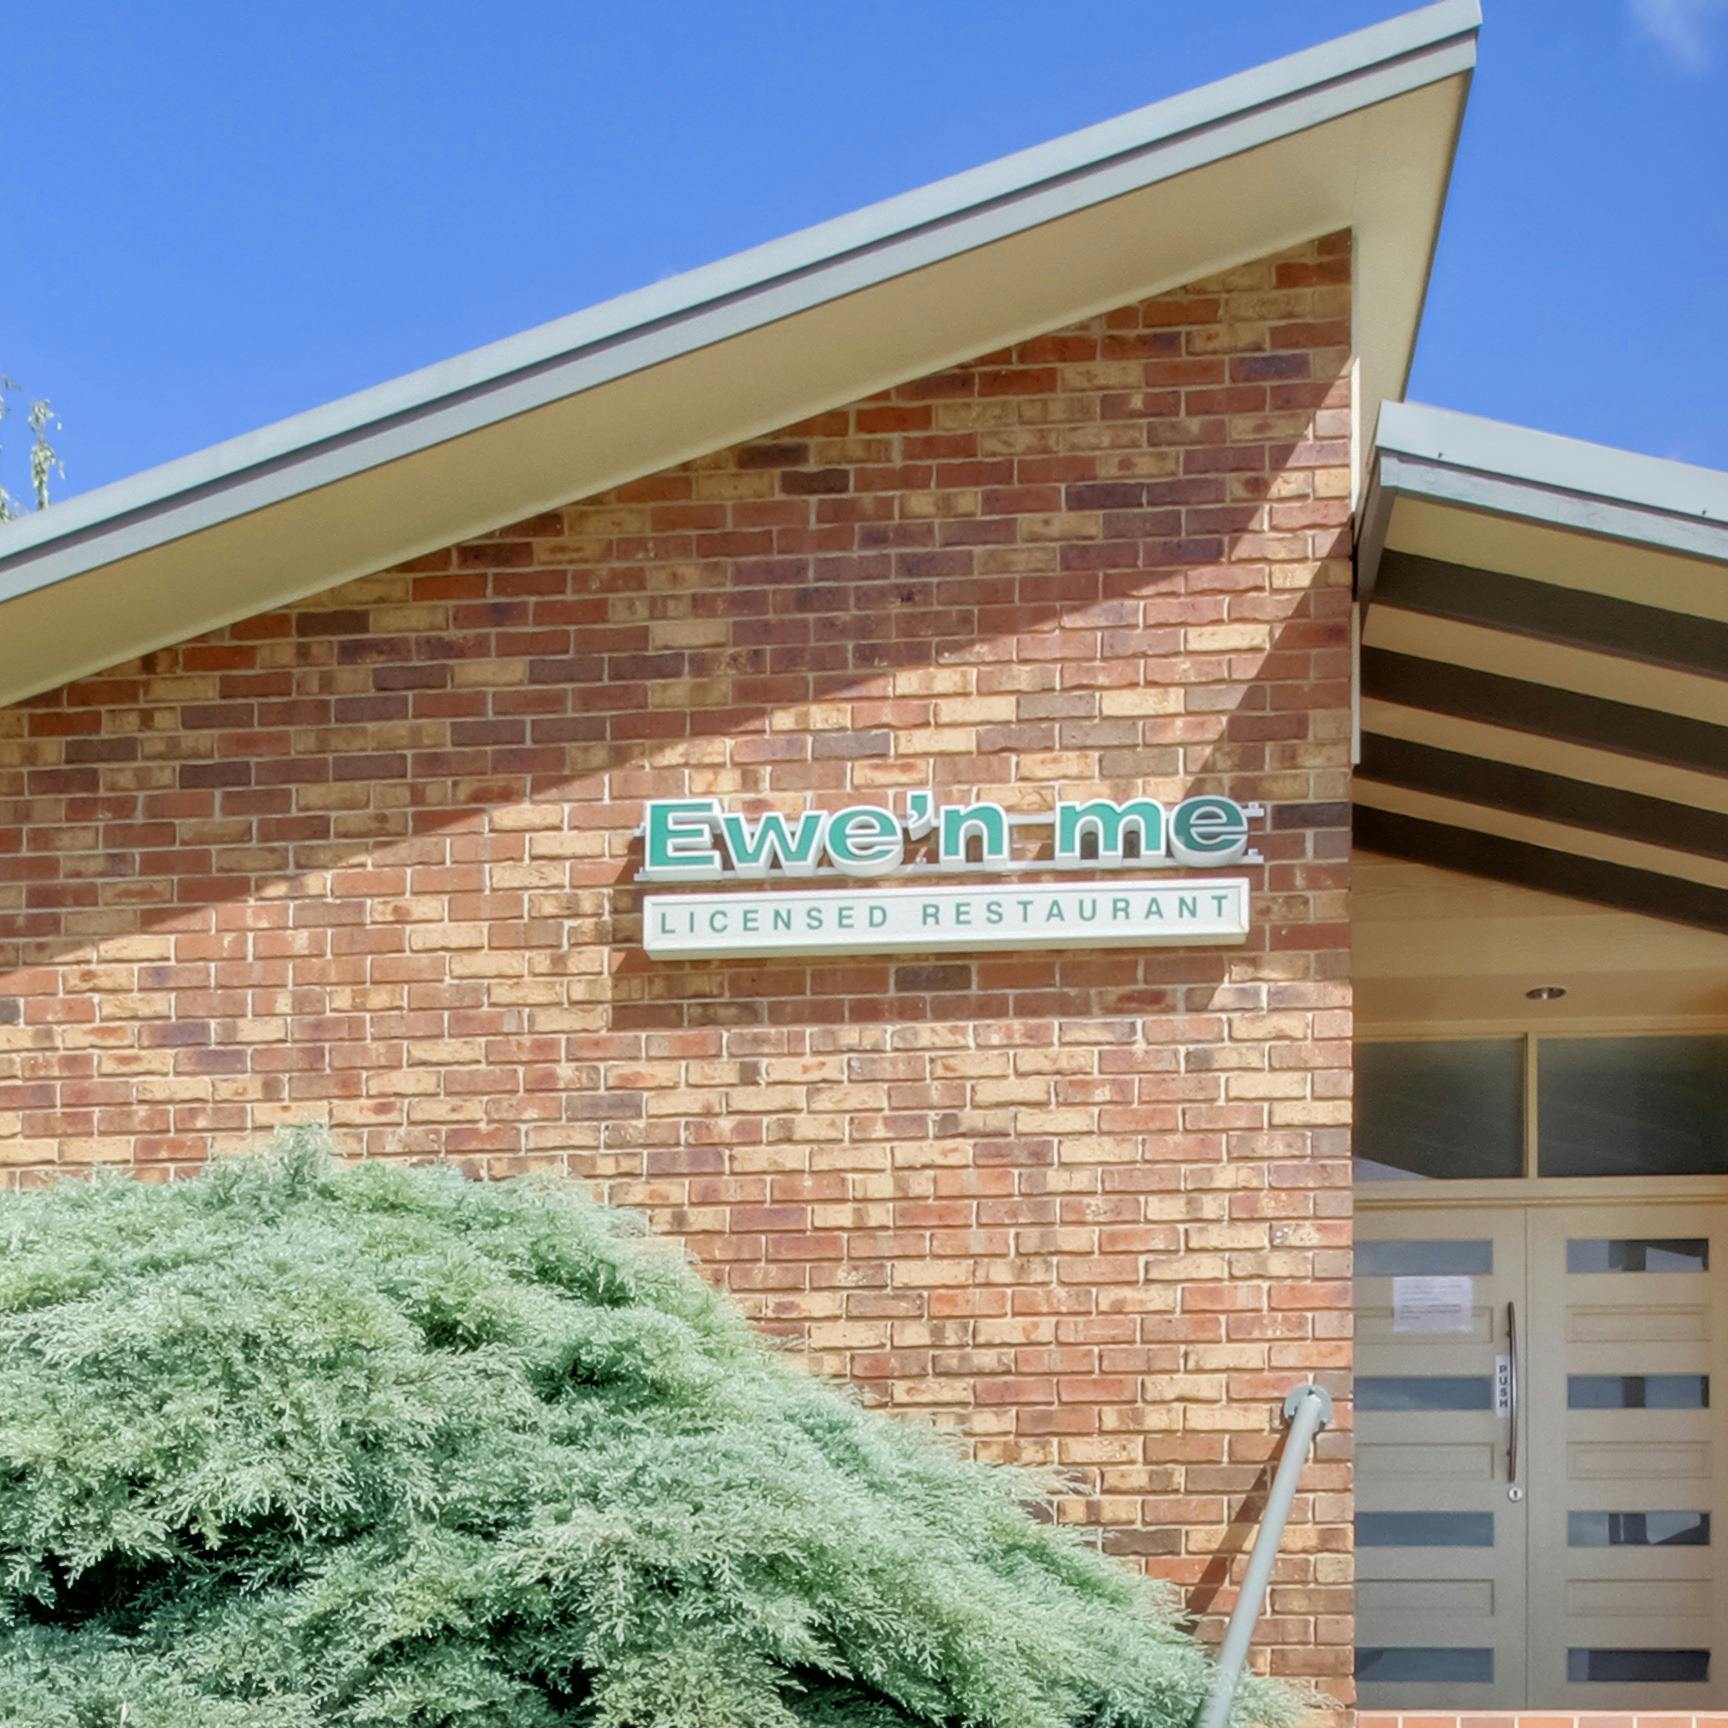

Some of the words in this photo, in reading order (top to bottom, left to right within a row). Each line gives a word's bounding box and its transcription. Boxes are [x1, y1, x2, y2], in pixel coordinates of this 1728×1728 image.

[645, 790, 1009, 876] Ewe'n
[1055, 795, 1249, 867] me
[660, 905, 888, 934] LICENSED
[922, 895, 1229, 926] RESTAURANT
[1499, 1365, 1508, 1408] PUSH
